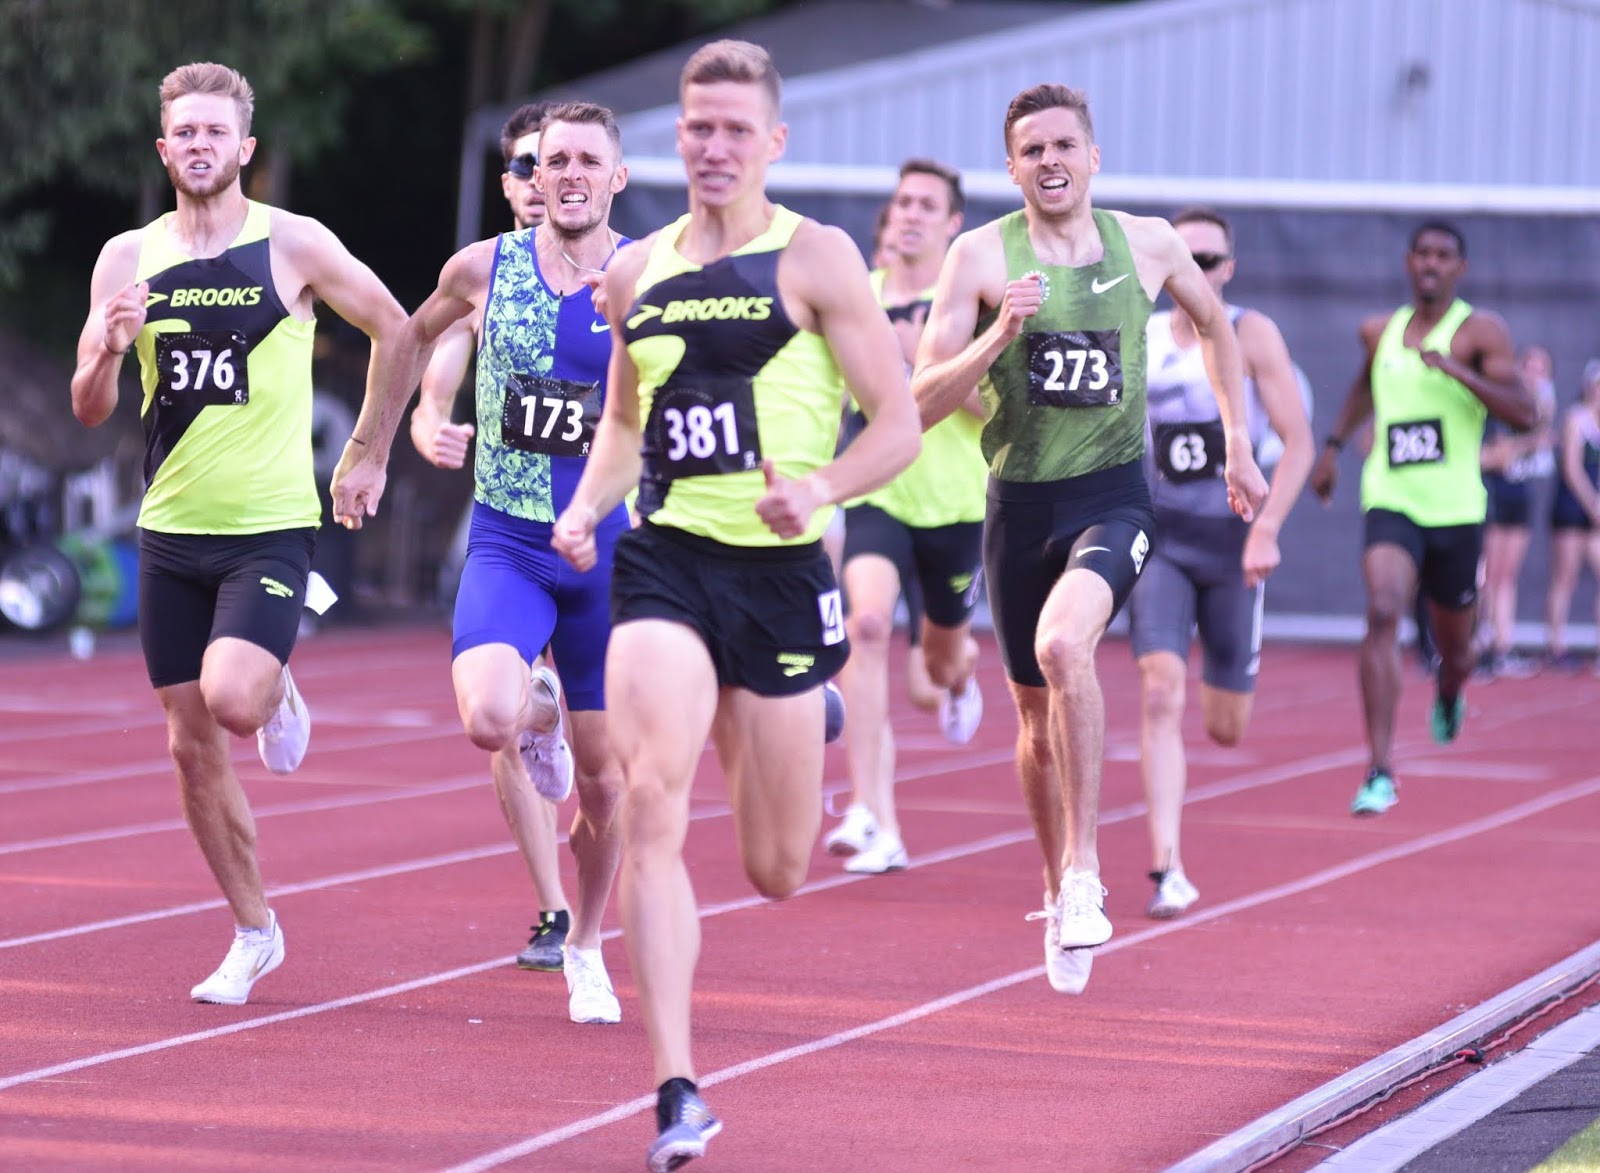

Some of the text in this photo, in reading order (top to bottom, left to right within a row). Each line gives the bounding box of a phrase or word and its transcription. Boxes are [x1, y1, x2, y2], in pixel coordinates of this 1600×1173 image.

[170, 287, 263, 307] BROOKS
[661, 297, 773, 323] BROOKS
[170, 349, 235, 391] 376
[1043, 349, 1109, 391] 273
[520, 395, 584, 442] 173
[664, 402, 739, 461] 381
[1170, 433, 1207, 472] 63
[1391, 425, 1441, 462] 262
